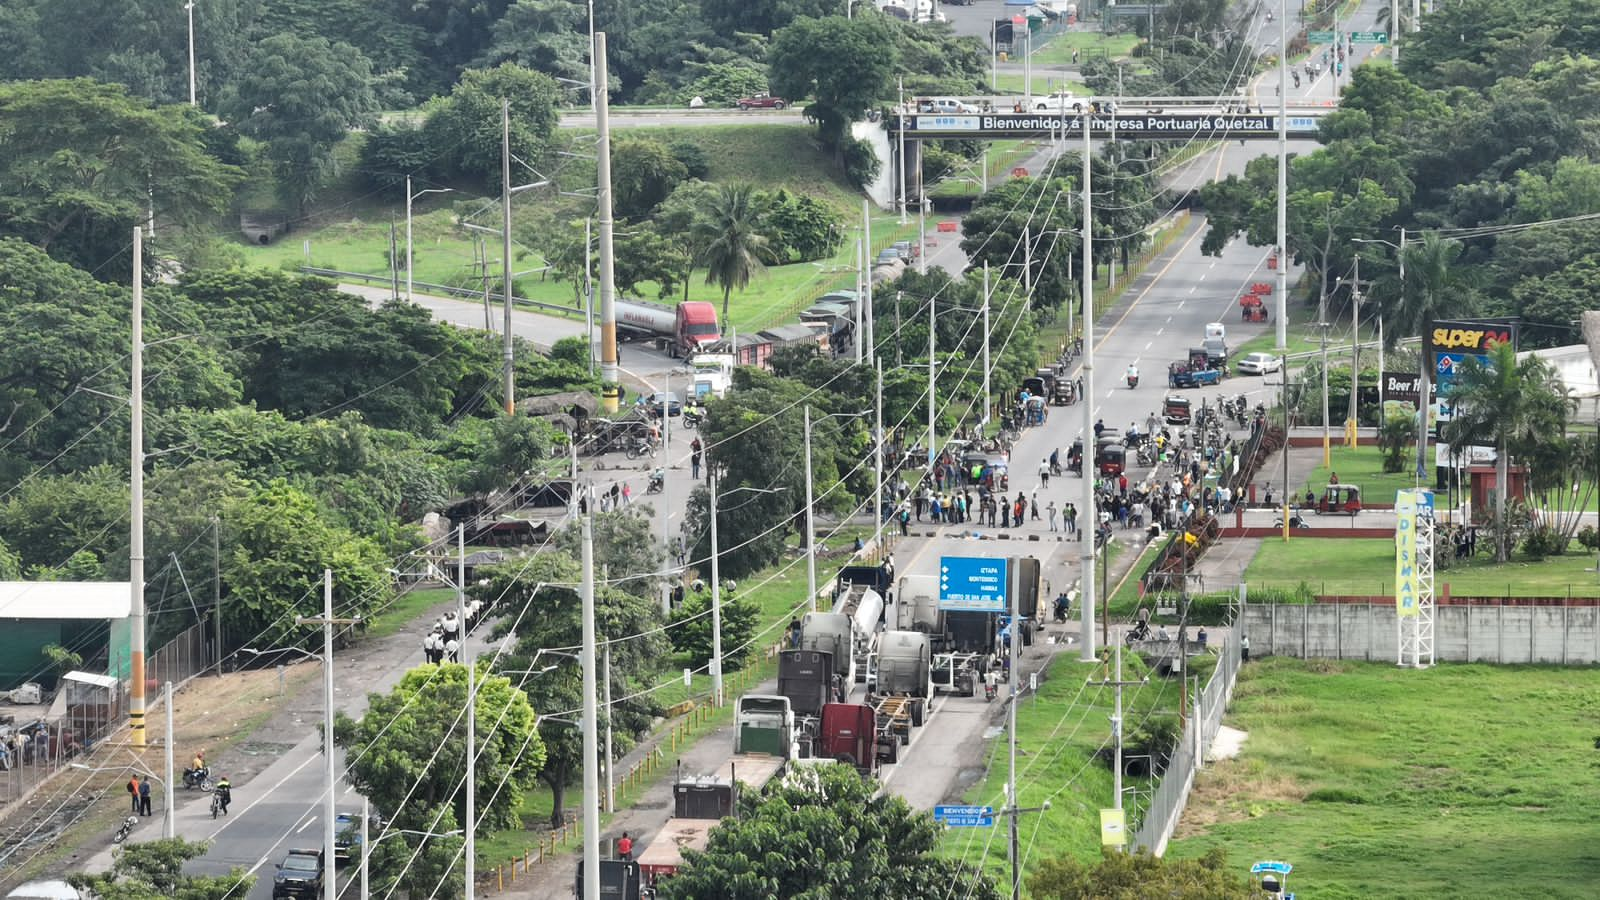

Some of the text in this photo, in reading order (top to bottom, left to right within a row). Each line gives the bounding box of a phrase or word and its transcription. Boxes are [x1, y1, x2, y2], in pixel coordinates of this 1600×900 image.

[984, 117, 1067, 129] Bienvenidos
[1084, 118, 1144, 131] mpresa
[1214, 117, 1268, 131] Quetzal
[1432, 328, 1484, 348] super
[1388, 377, 1411, 392] Beer
[1412, 378, 1437, 393] Hs
[1400, 519, 1413, 608] DISMAR
